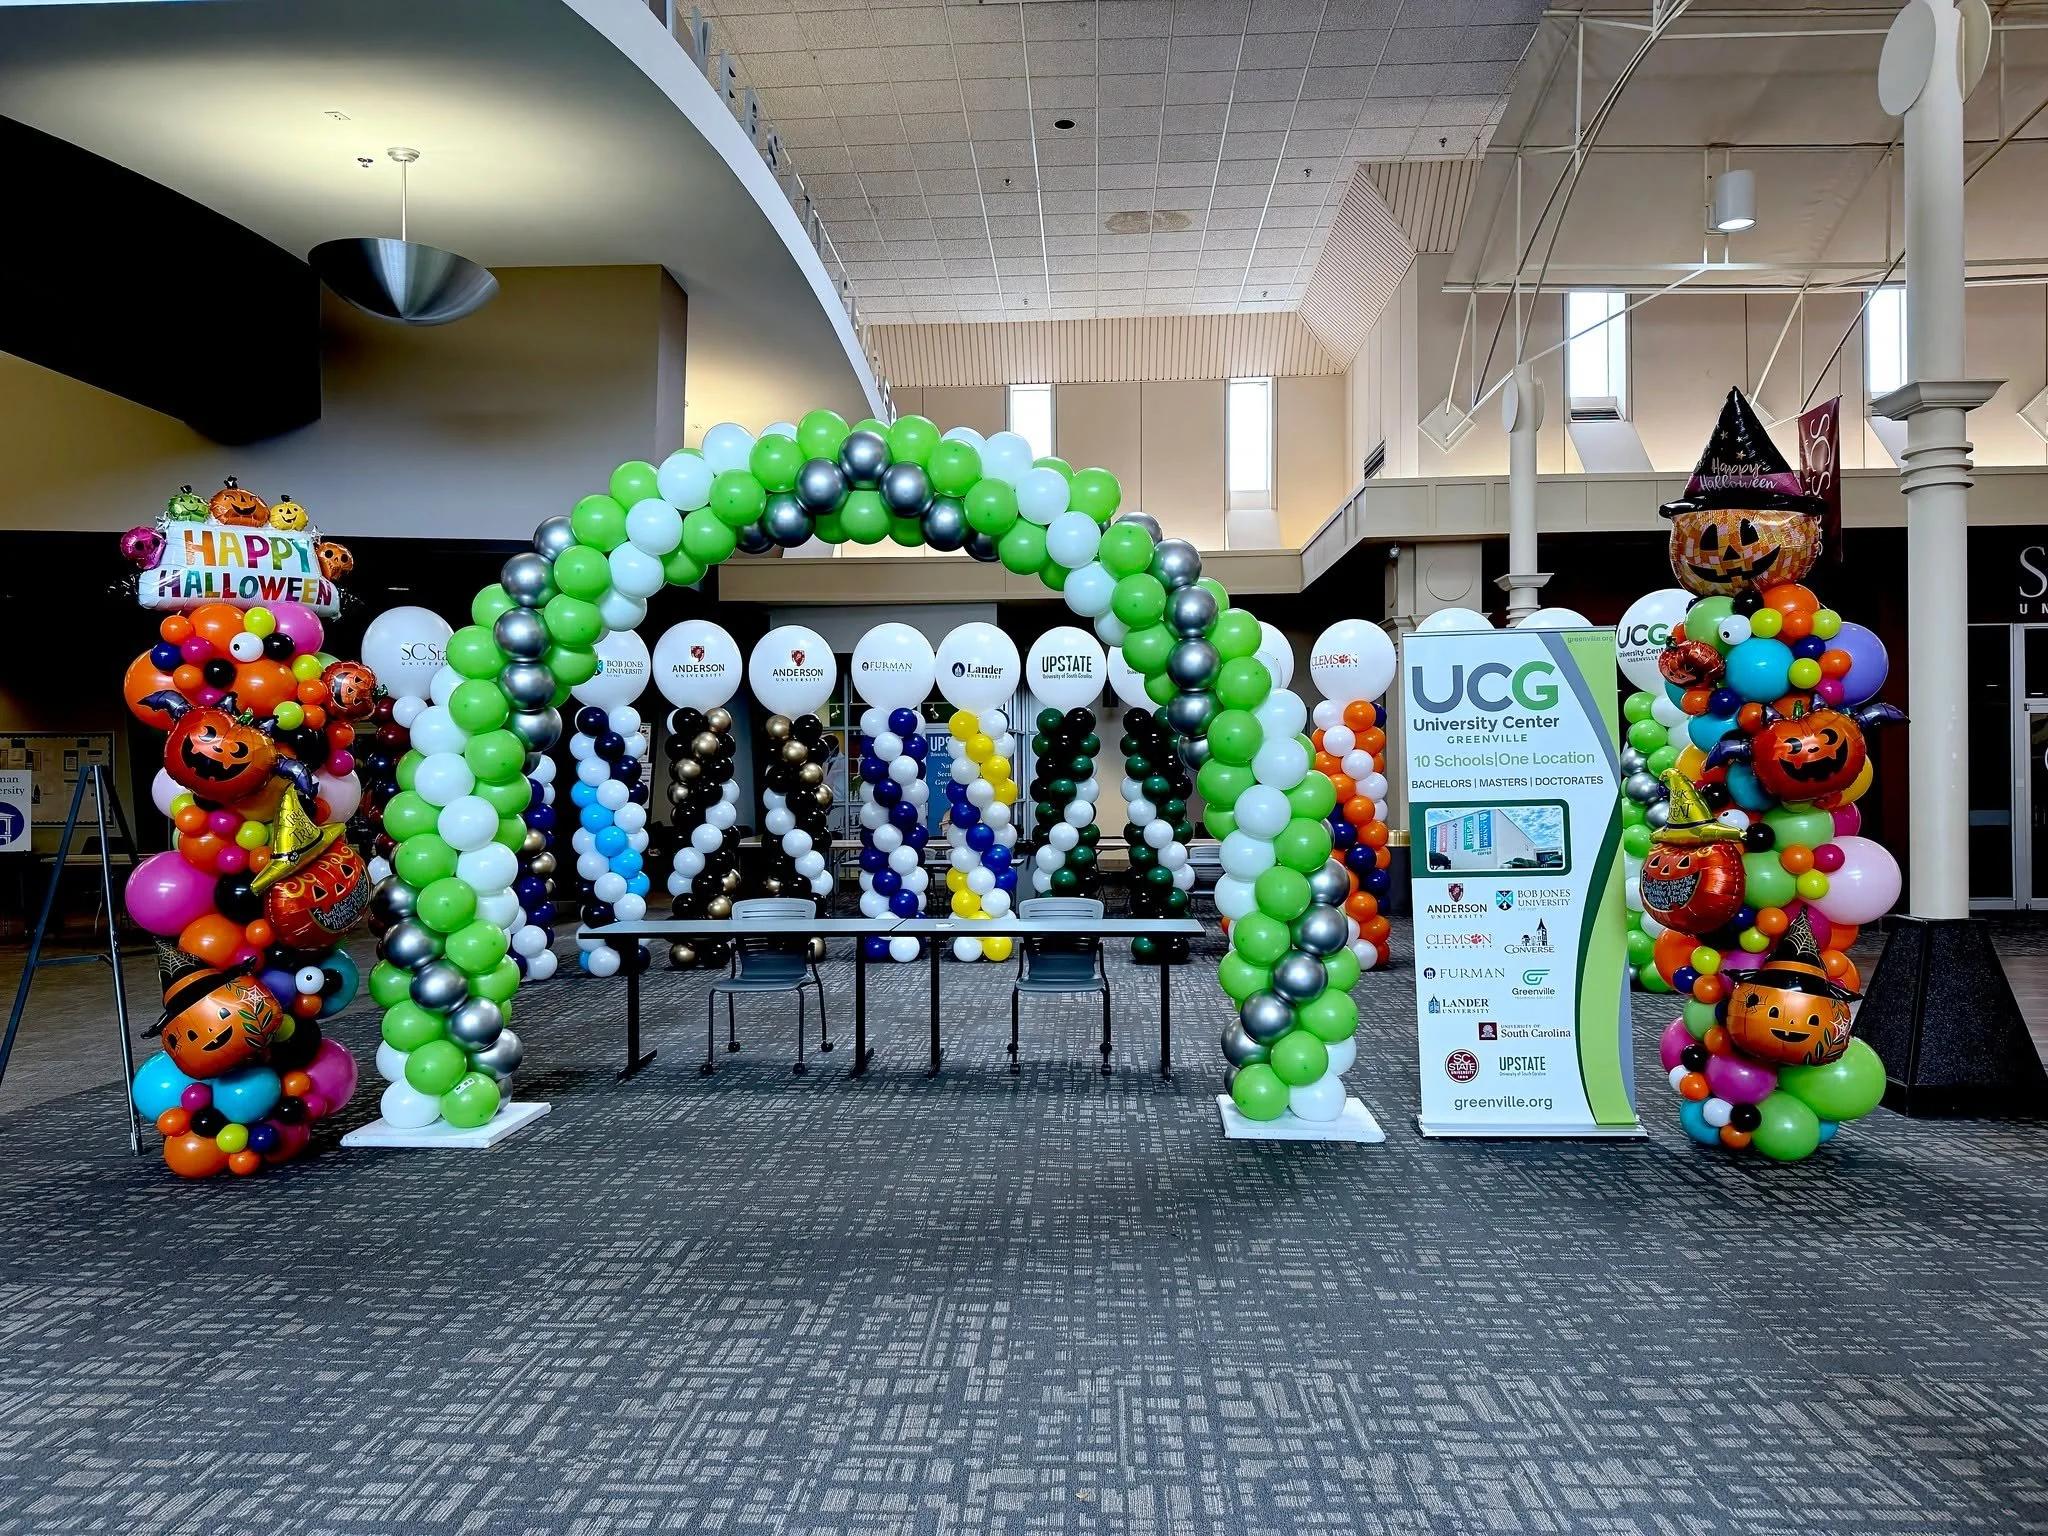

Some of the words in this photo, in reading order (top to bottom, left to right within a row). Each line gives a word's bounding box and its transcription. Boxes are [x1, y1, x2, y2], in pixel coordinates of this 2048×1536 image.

[1711, 457, 1762, 479] Happy
[1700, 474, 1778, 491] Halloween
[184, 529, 311, 573] HAPPY
[158, 569, 332, 607] HALLOWEEN
[1617, 623, 1669, 649] UCG
[401, 642, 447, 661] SCSta
[624, 660, 644, 668] JONES
[672, 663, 725, 673] ANDERSON
[870, 661, 913, 670] FURMAN
[967, 663, 1004, 675] Lander
[1042, 655, 1092, 673] UPSTATE
[606, 667, 643, 675] UNIVERSITY
[772, 668, 824, 677] ANDERSON
[1411, 660, 1560, 714] UCG
[1413, 716, 1499, 733] University
[1503, 715, 1560, 729] Center
[1447, 734, 1528, 744] GREENVILLE
[1414, 755, 1431, 768] 10
[1533, 752, 1595, 765] Location
[1411, 779, 1472, 789] BACHELORS
[1479, 777, 1528, 788] MASTERS
[1535, 775, 1604, 786] DOCTORATES
[1517, 889, 1538, 898] BOB
[1540, 889, 1571, 899] JONES
[1427, 904, 1488, 914] ANDERSON
[1517, 899, 1571, 907] UNIVERSITY
[1440, 967, 1505, 979] FURMAN
[1511, 987, 1556, 996] Greenville
[1442, 998, 1490, 1008] LANDER
[1500, 1028, 1529, 1038] South
[1531, 1028, 1572, 1038] Carolina
[1453, 1053, 1471, 1064] SC
[1499, 1056, 1546, 1071] UPSTATE
[1448, 1062, 1476, 1071] STATE
[1454, 1096, 1553, 1110] greenville.org
